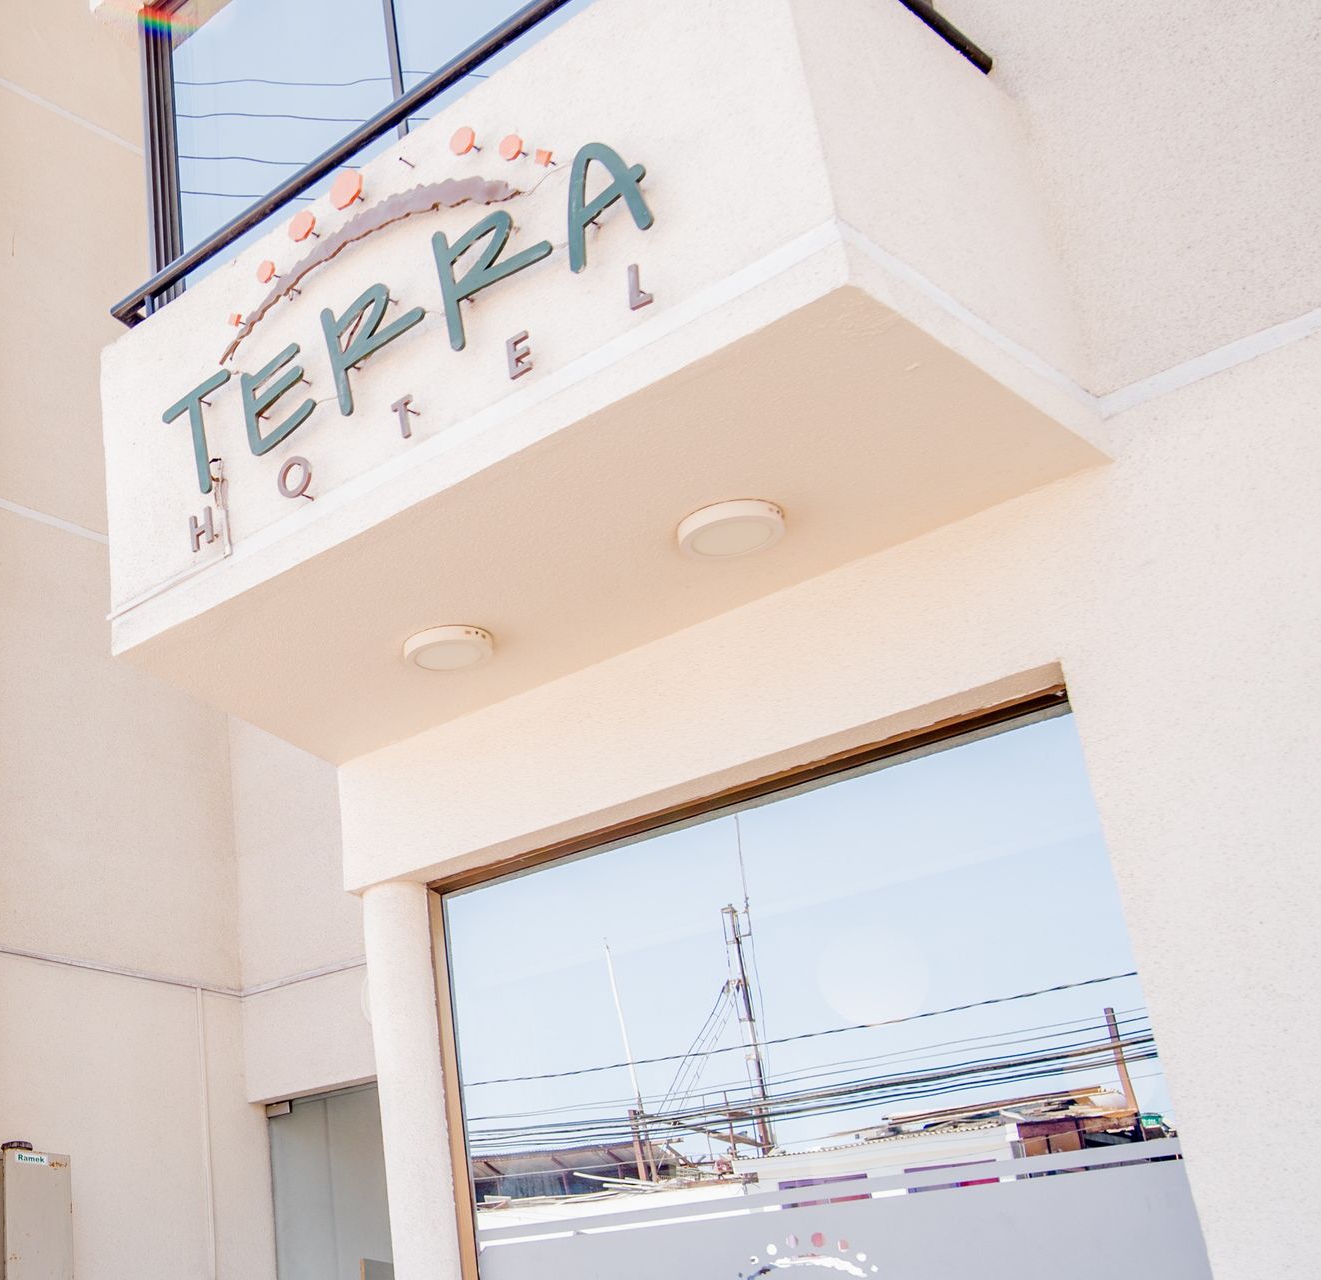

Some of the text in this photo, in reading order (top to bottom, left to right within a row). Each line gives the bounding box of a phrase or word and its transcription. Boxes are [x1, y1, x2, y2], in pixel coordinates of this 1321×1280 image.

[162, 142, 654, 494] TERRA
[189, 264, 654, 552] HOTEL
[17, 1154, 45, 1163] Ramek
